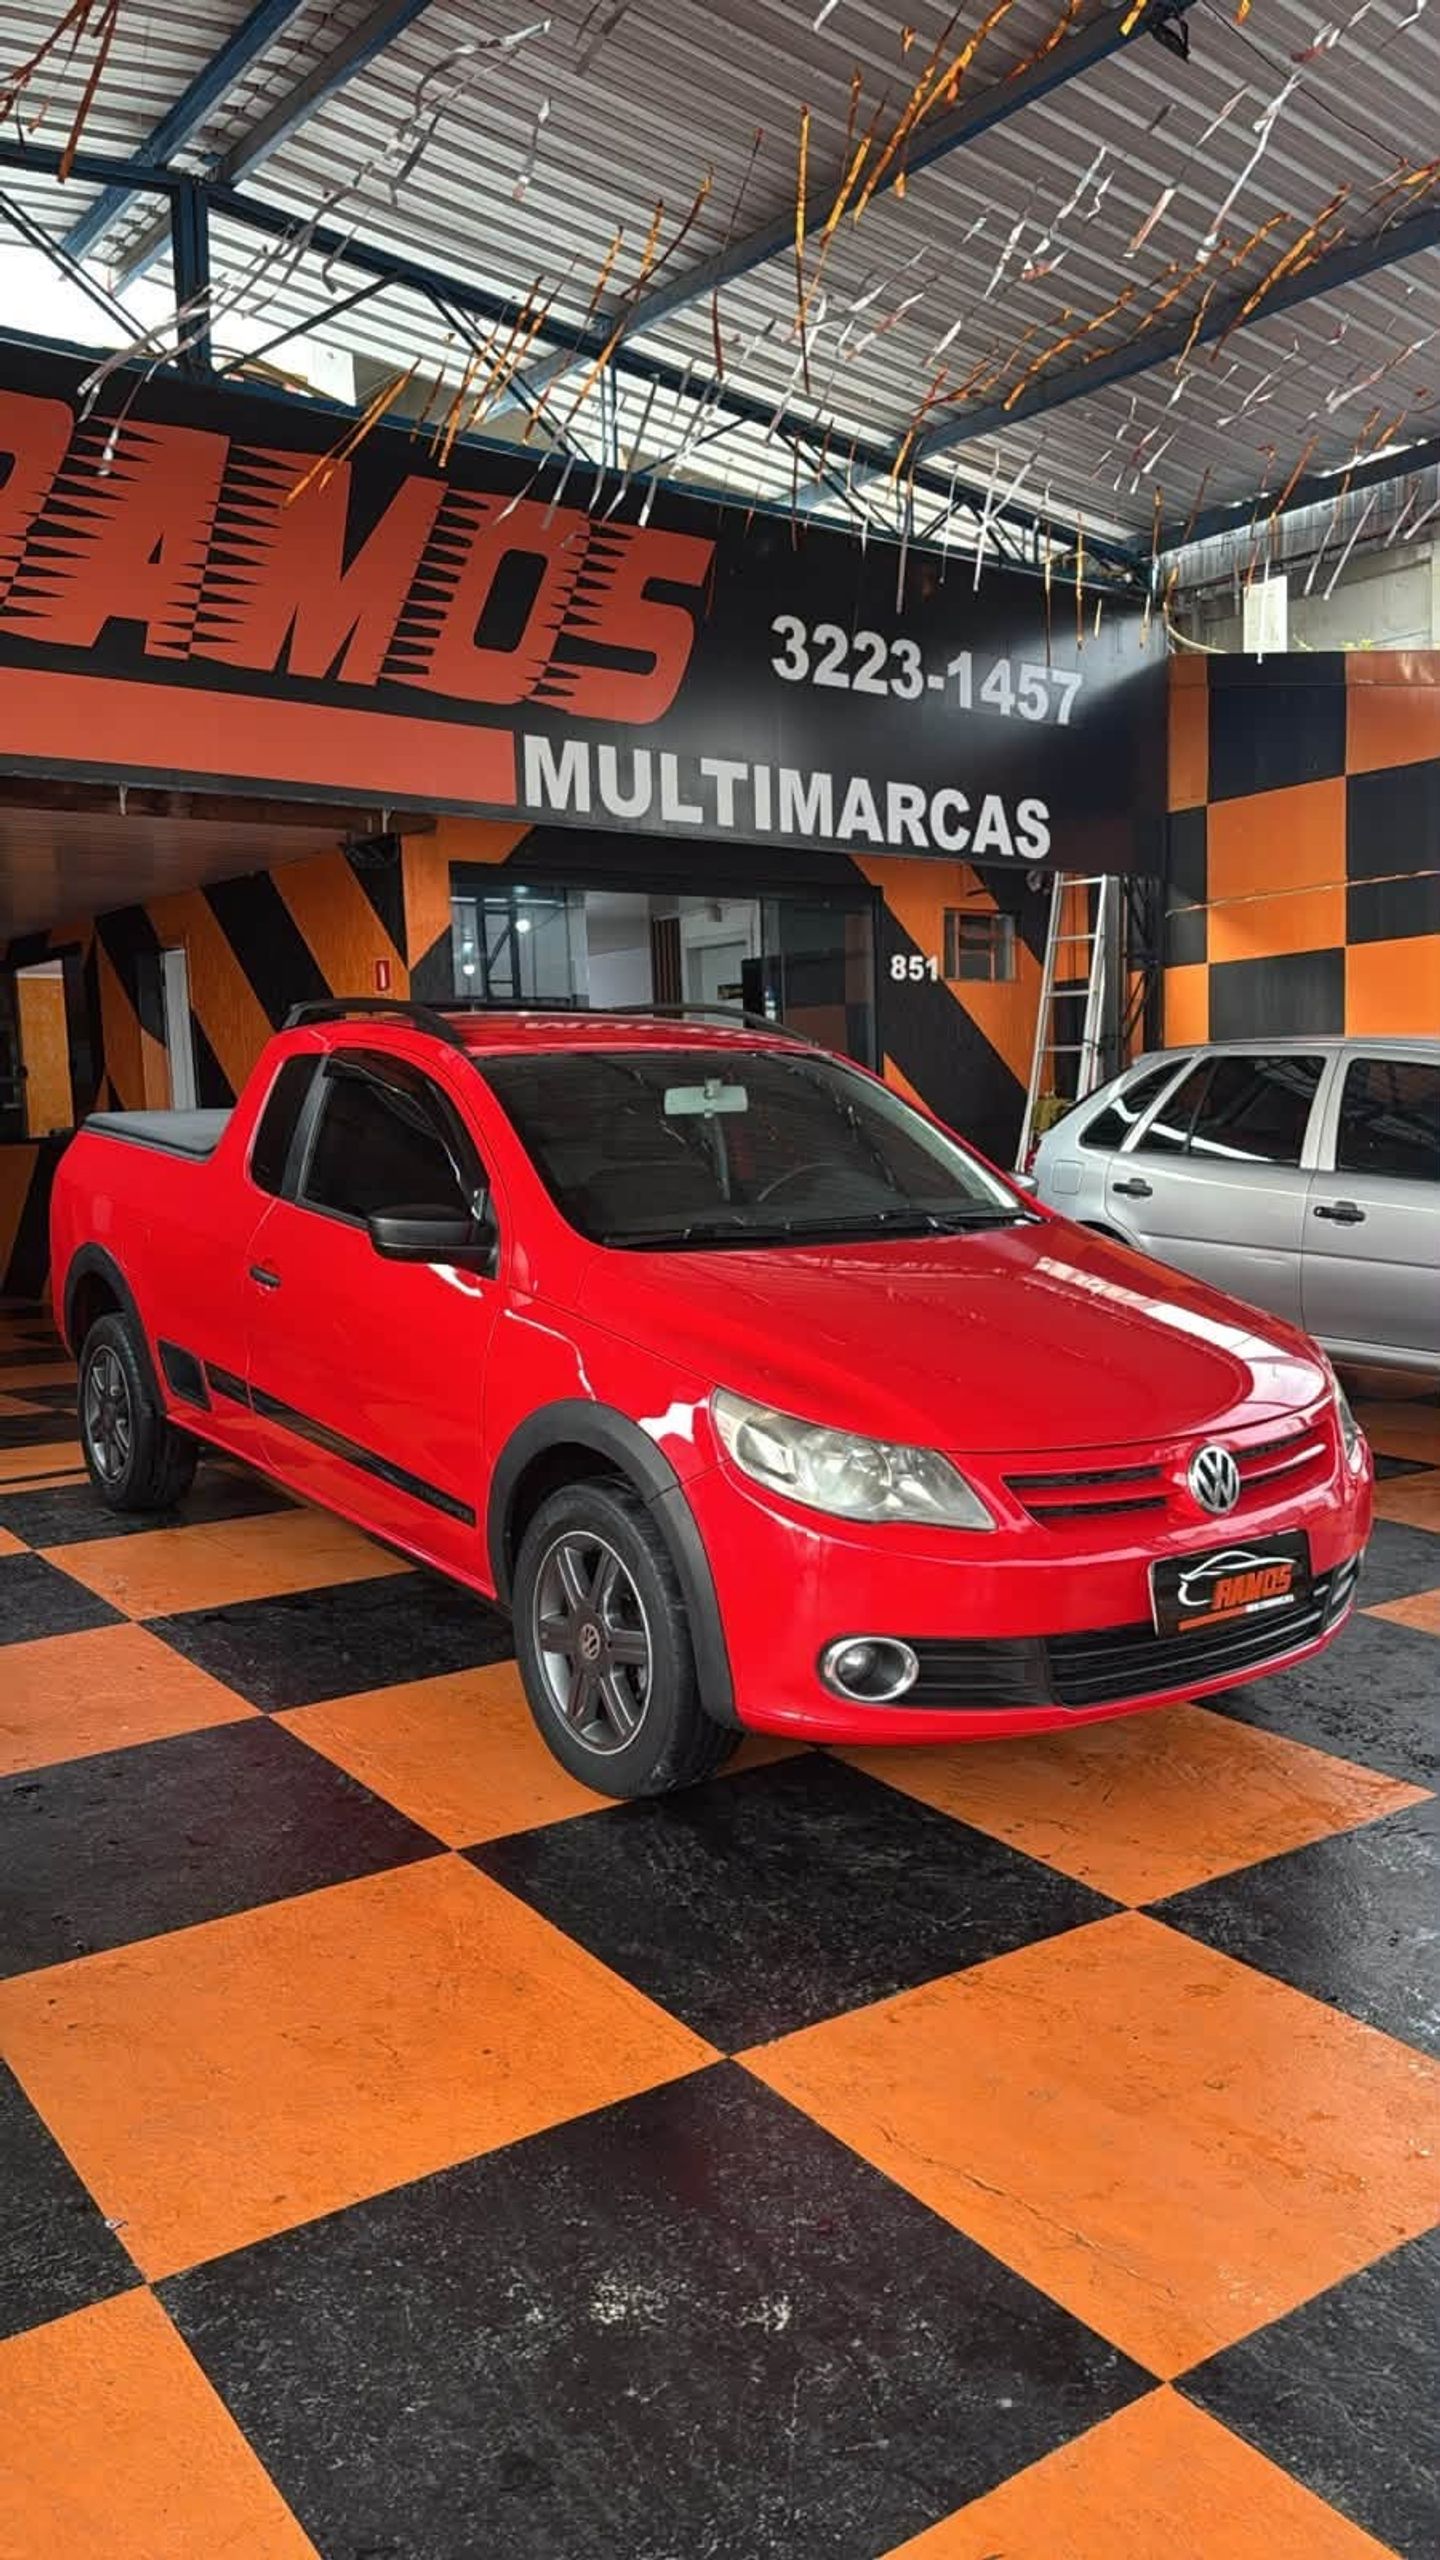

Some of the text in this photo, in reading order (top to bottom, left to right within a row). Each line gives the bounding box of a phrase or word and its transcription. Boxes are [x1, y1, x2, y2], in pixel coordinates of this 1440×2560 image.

[771, 615, 1083, 725] 3223-1457
[524, 735, 1051, 859] MULTIMARCAS
[890, 954, 938, 982] 851
